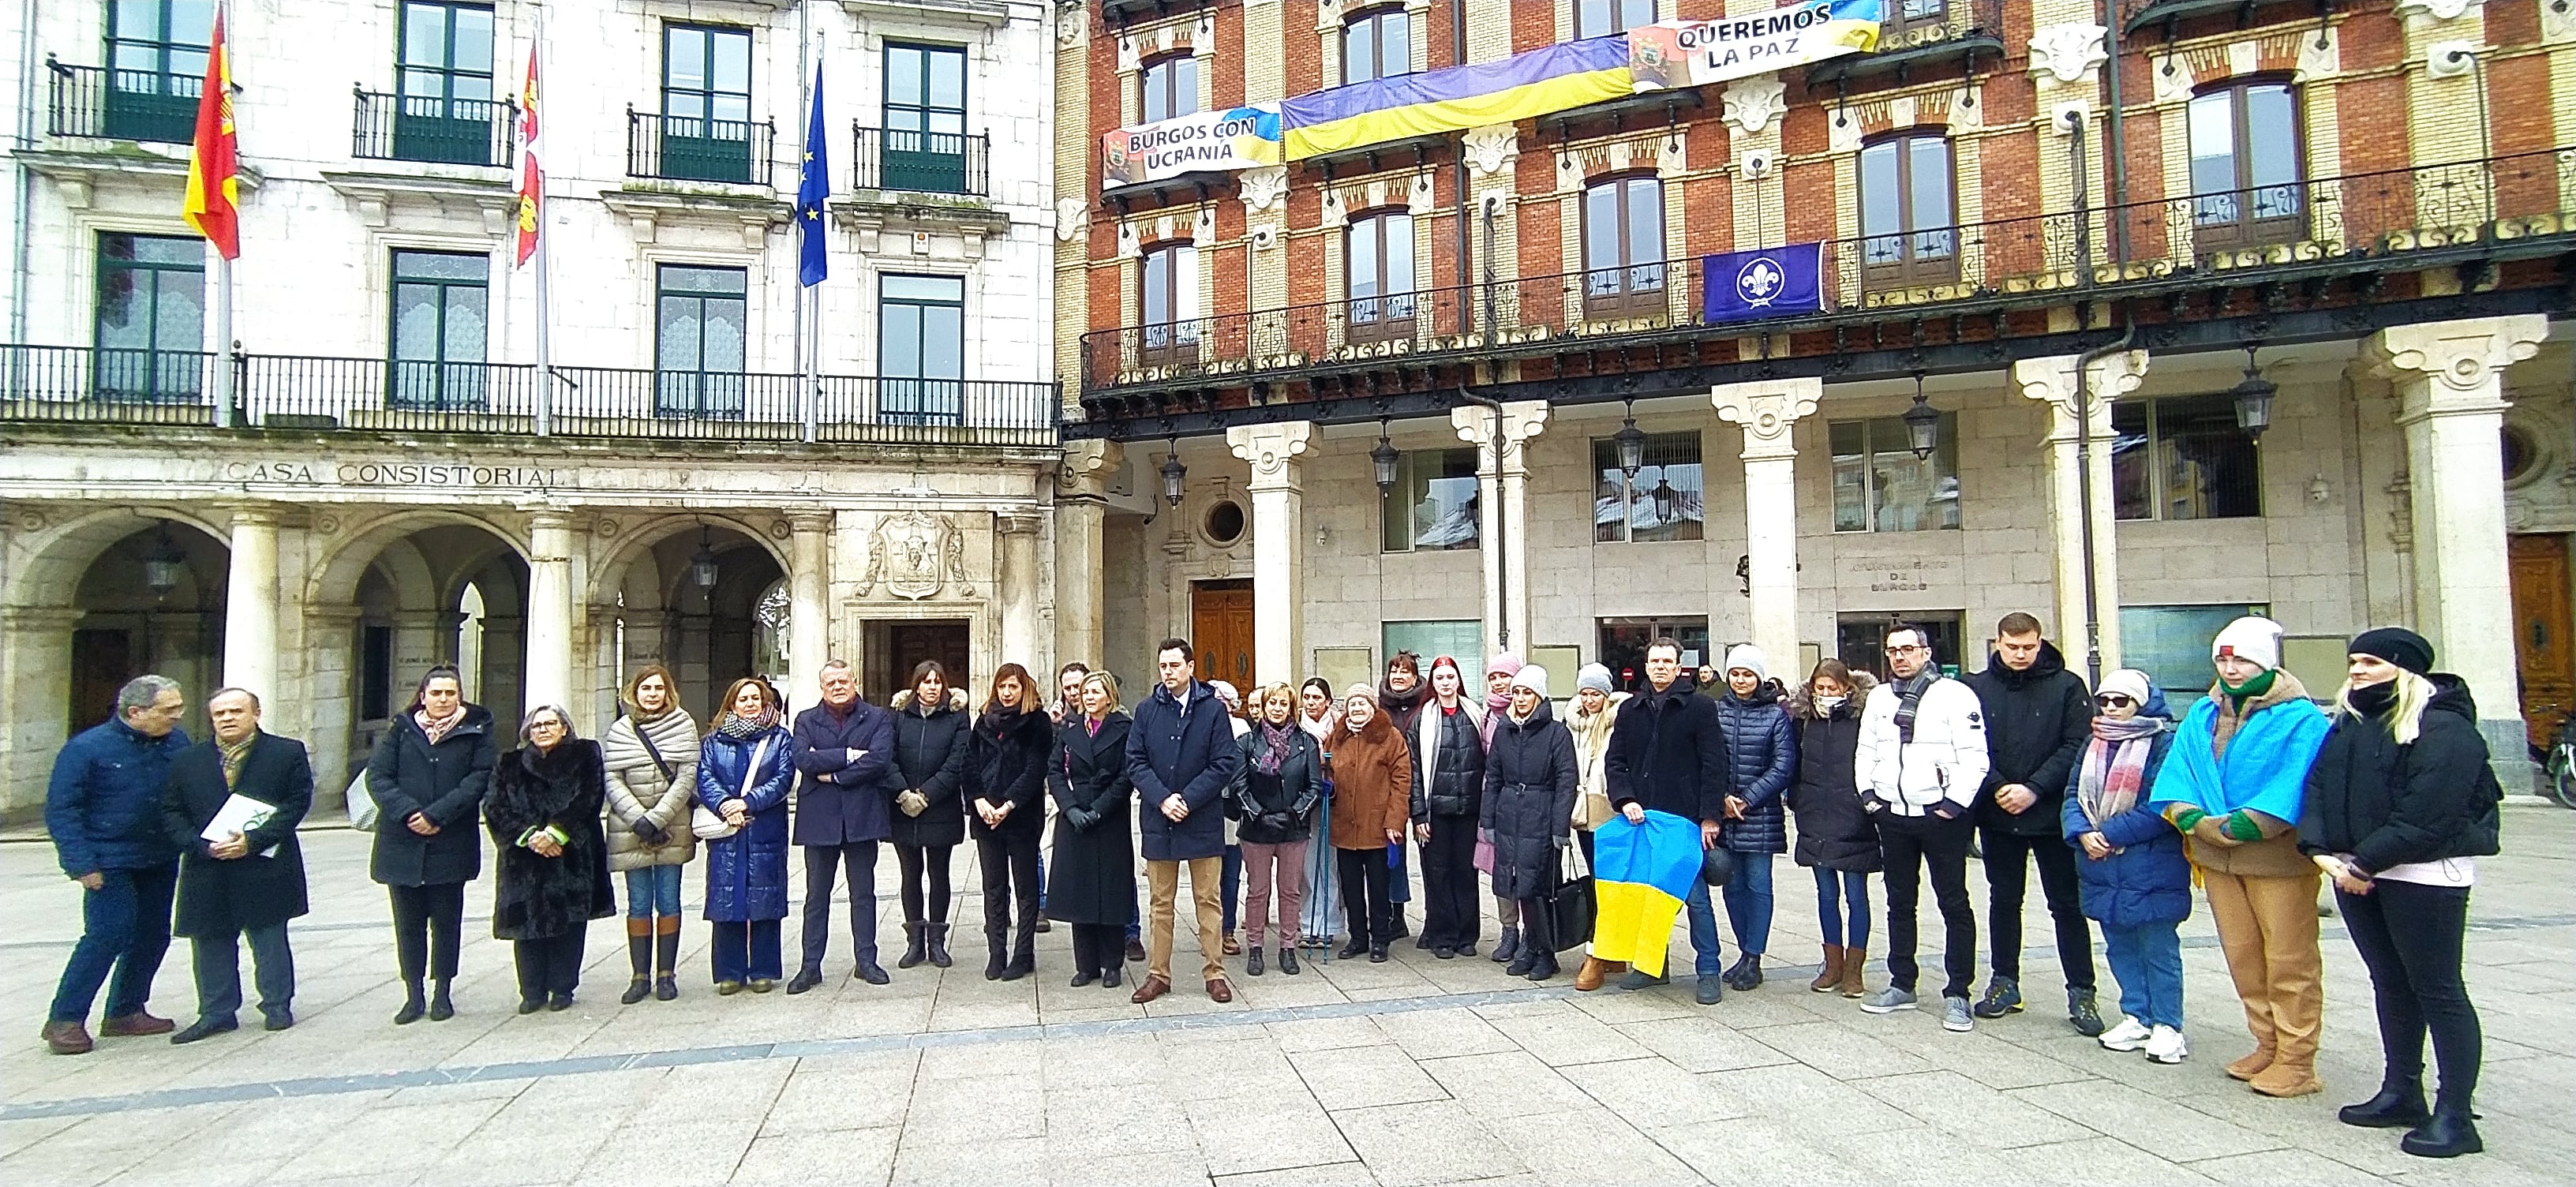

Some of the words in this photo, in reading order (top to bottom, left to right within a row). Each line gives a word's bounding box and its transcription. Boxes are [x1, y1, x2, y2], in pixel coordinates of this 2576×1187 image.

[1679, 5, 1831, 48] QUEREMOS
[1708, 49, 1738, 69] LA
[1749, 38, 1799, 60] PAZ
[1130, 125, 1207, 152] BURGOS
[1213, 118, 1254, 137] CON
[227, 462, 313, 481] CASA
[337, 464, 565, 485] CONSISTORIAL
[242, 809, 271, 832] OX
